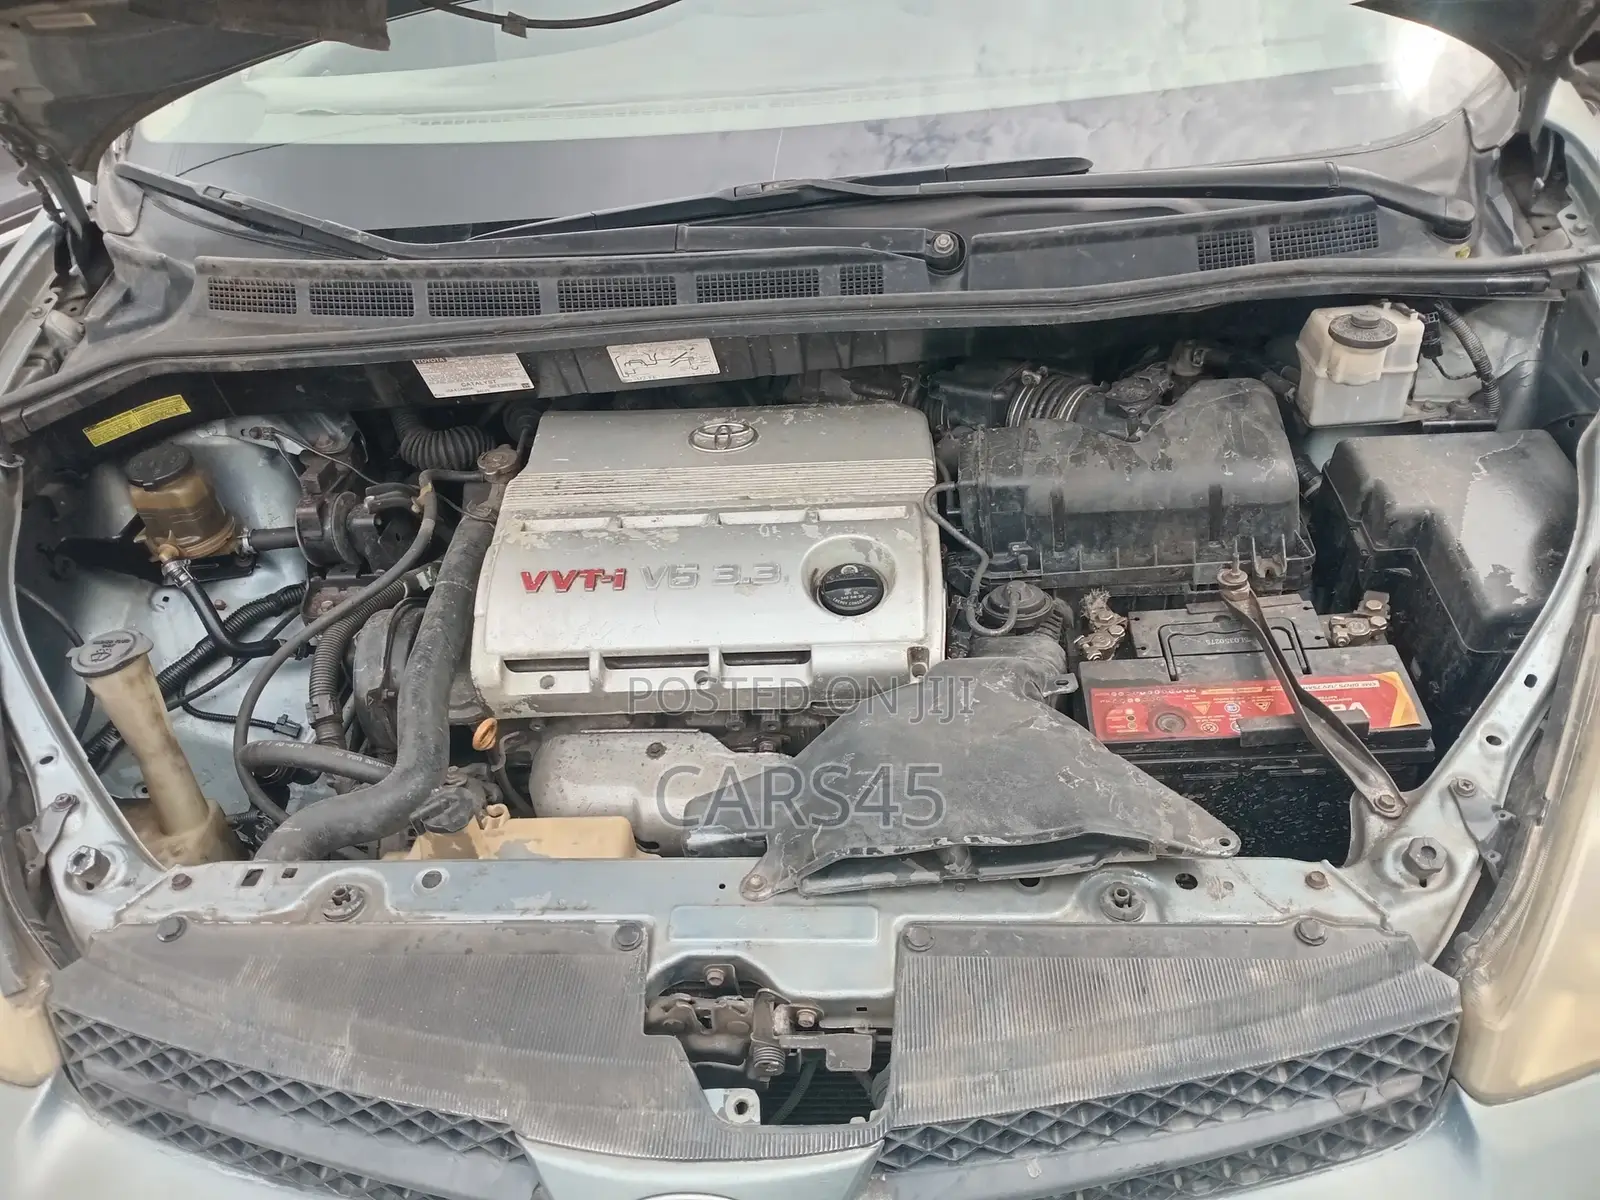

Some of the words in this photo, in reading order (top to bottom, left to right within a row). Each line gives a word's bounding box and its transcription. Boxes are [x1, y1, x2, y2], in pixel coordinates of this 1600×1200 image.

[460, 380, 497, 388] CATALYST
[520, 567, 628, 594] VVT-i
[639, 563, 701, 592] V6
[711, 563, 782, 587] 3.3
